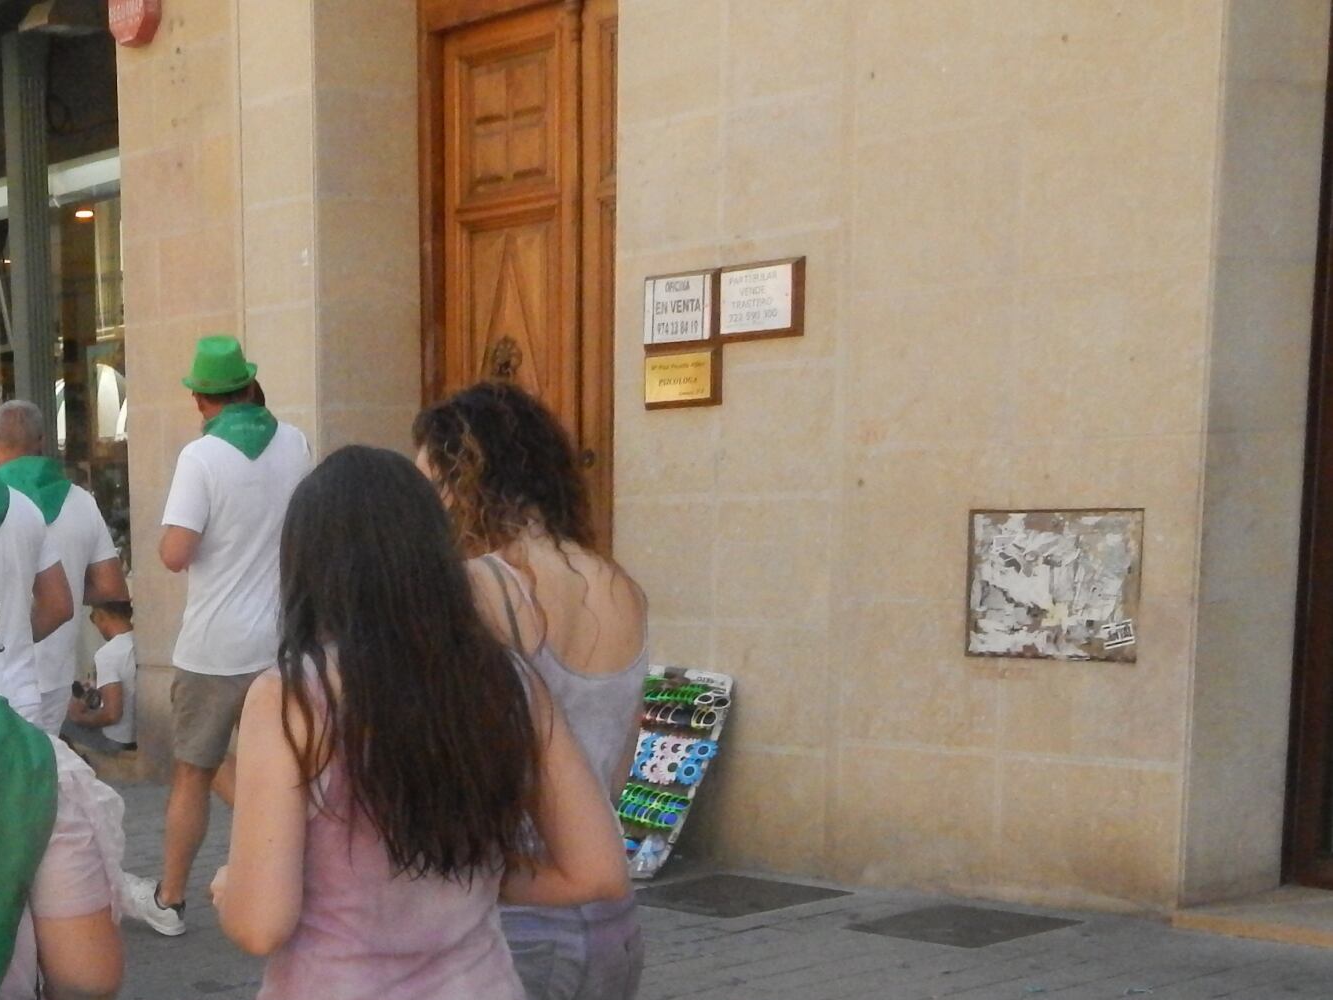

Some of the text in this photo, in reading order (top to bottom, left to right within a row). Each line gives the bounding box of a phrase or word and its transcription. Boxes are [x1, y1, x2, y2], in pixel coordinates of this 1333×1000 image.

[665, 280, 690, 292] OFICINA
[739, 286, 766, 296] VENDE
[656, 298, 701, 315] EN VENTA
